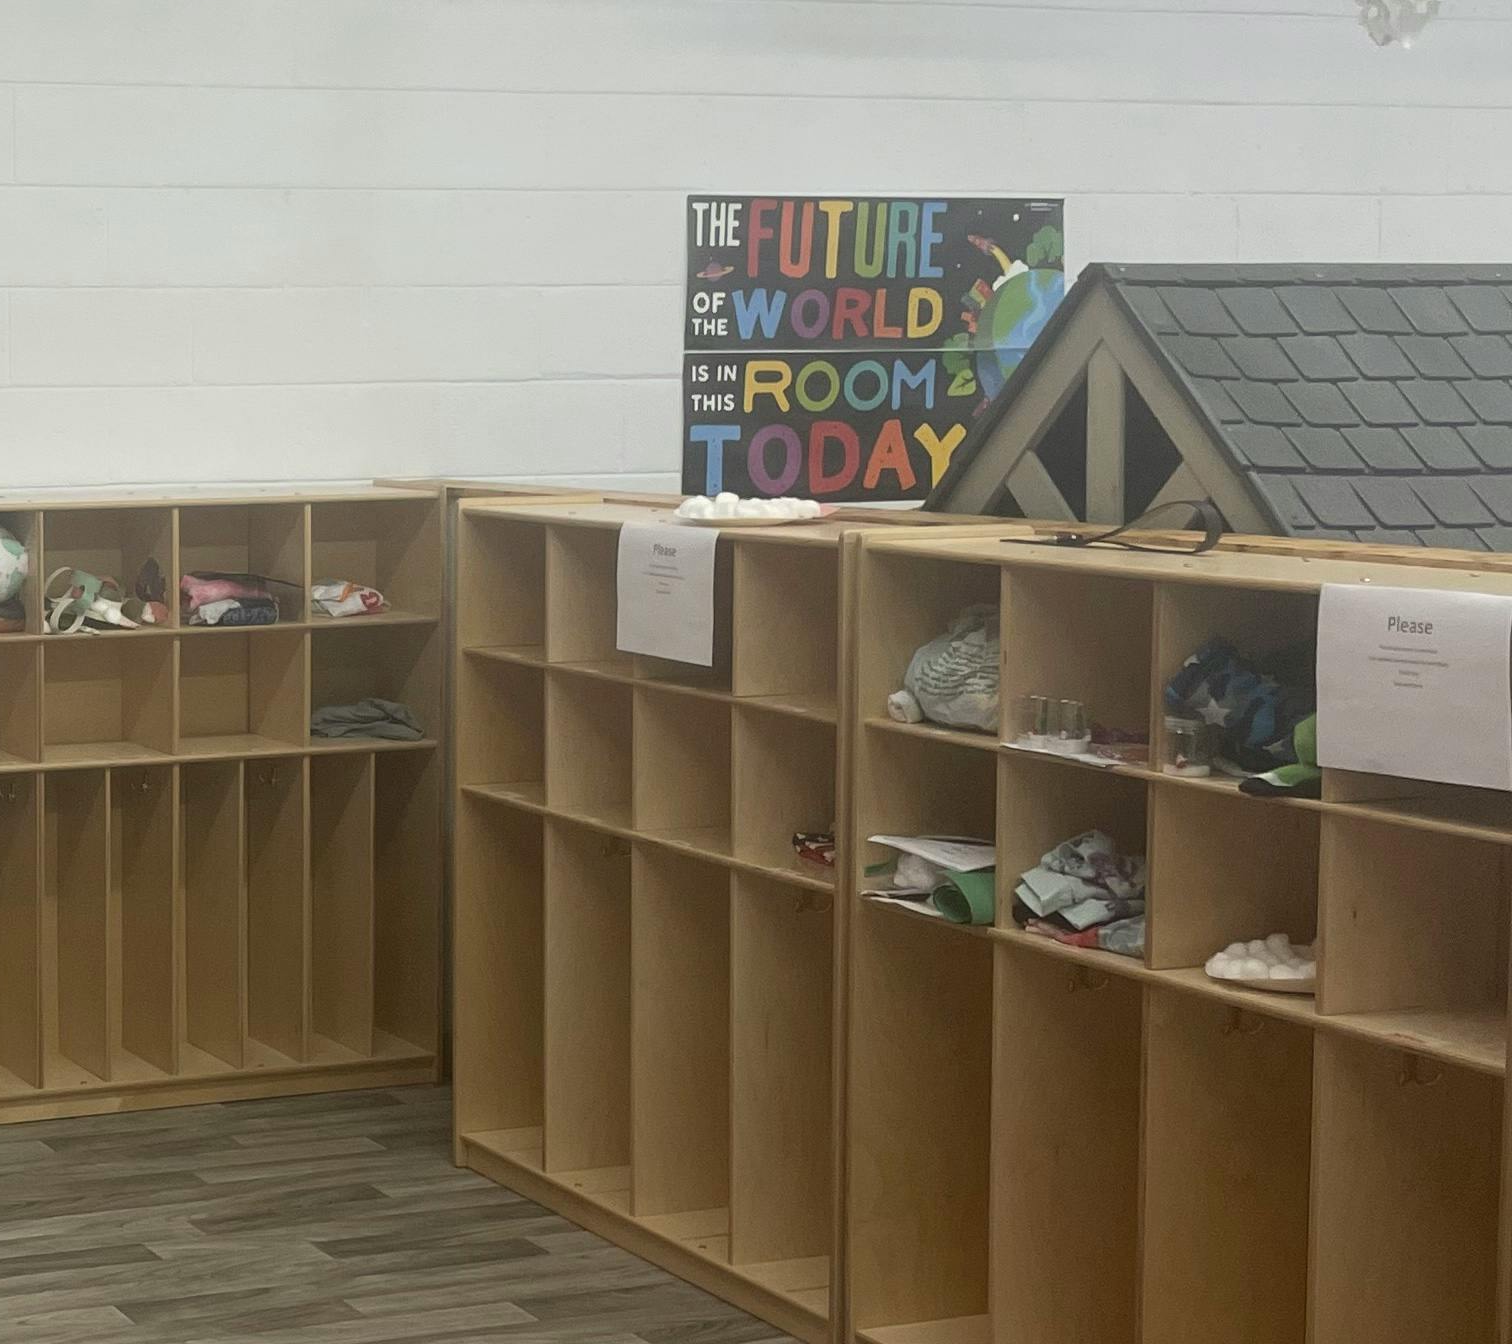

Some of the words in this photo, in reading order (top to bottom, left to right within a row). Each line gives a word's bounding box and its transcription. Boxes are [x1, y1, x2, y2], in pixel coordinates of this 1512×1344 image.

[692, 202, 742, 246] THE
[747, 199, 947, 279] FUTURE
[693, 292, 726, 313] OF
[731, 287, 943, 340] WORLD
[692, 318, 728, 336] THE
[691, 365, 709, 383] IS
[717, 364, 737, 383] IN
[743, 359, 937, 413] ROOM
[691, 394, 735, 413] THIS
[690, 418, 968, 497] TODAY
[1388, 616, 1433, 635] Please
